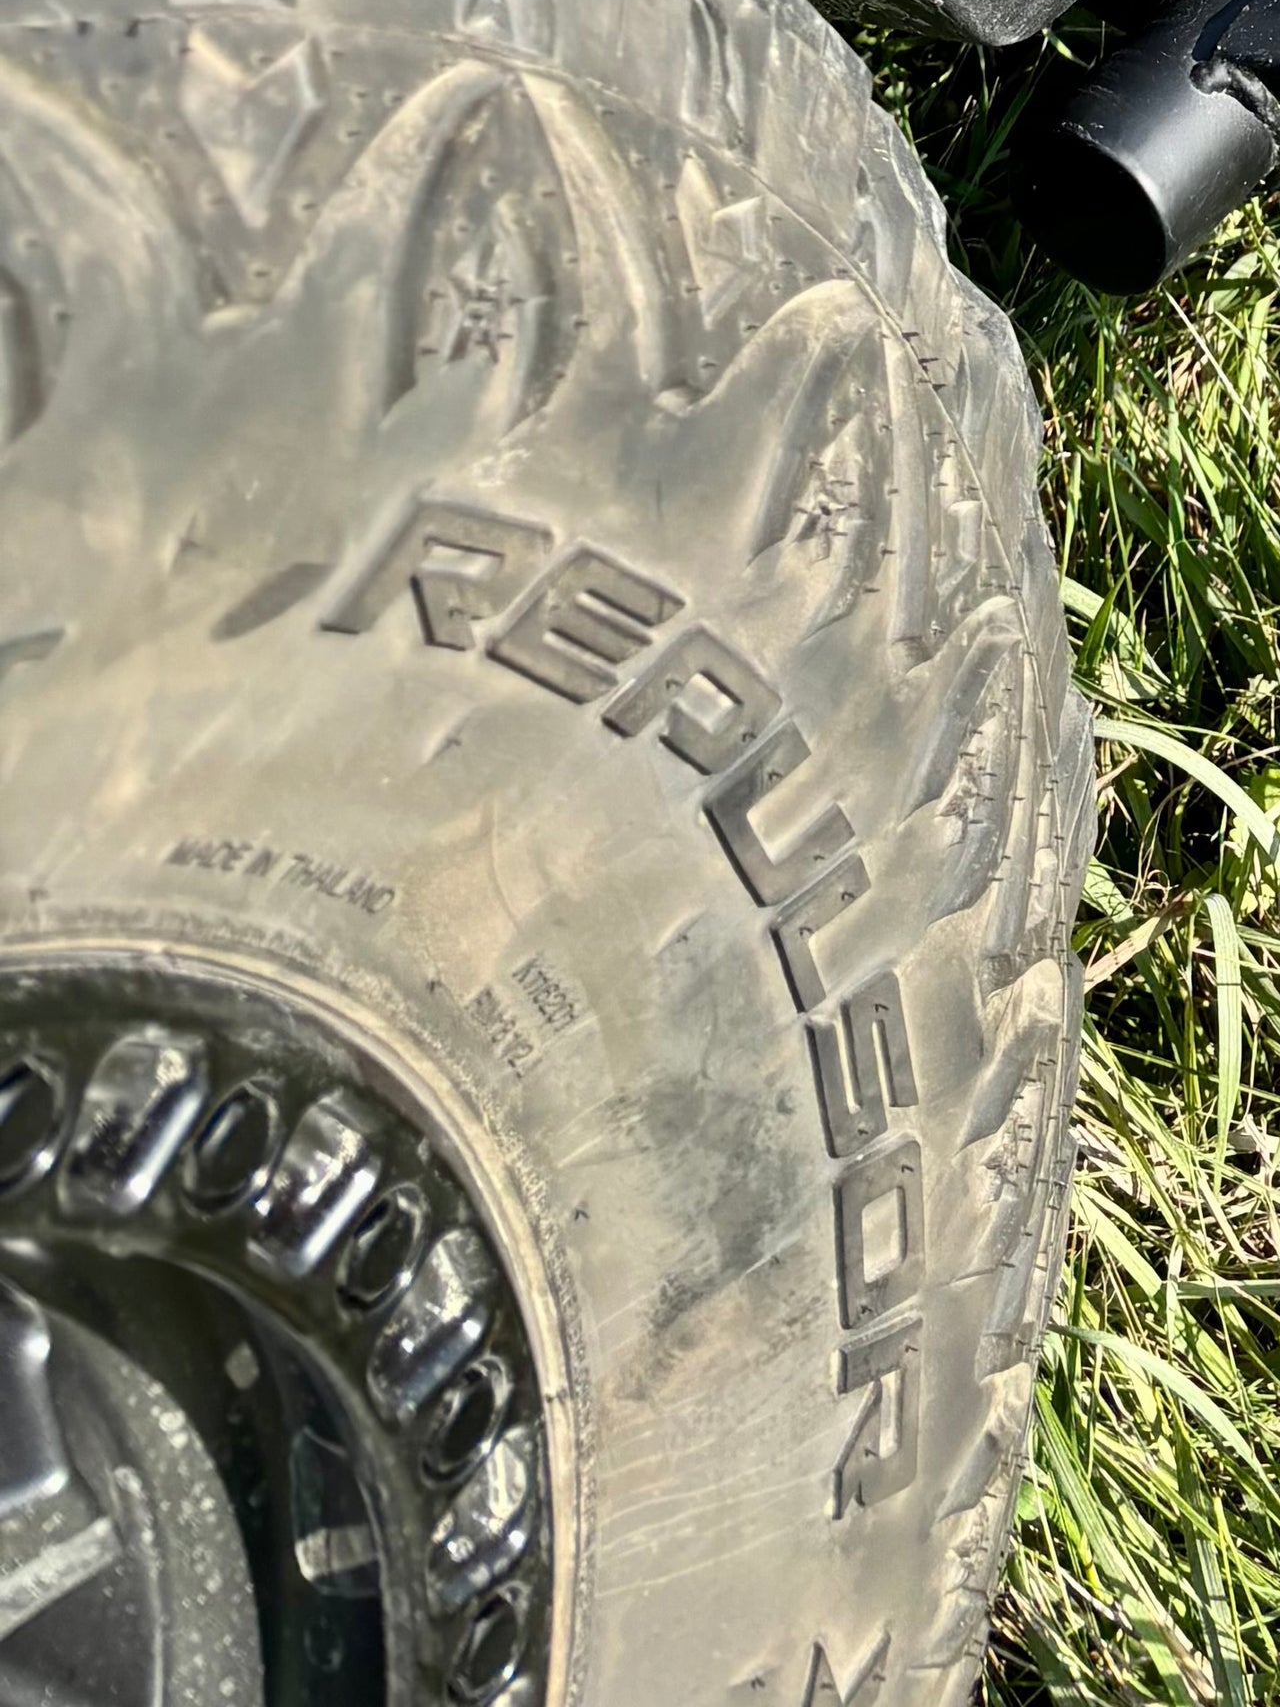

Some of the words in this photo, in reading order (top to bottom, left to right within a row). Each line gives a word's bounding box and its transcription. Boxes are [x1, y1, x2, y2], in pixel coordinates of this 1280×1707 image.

[167, 838, 253, 873] MADE
[281, 852, 395, 915] THAILAND
[318, 497, 925, 1521] REPULSOR
